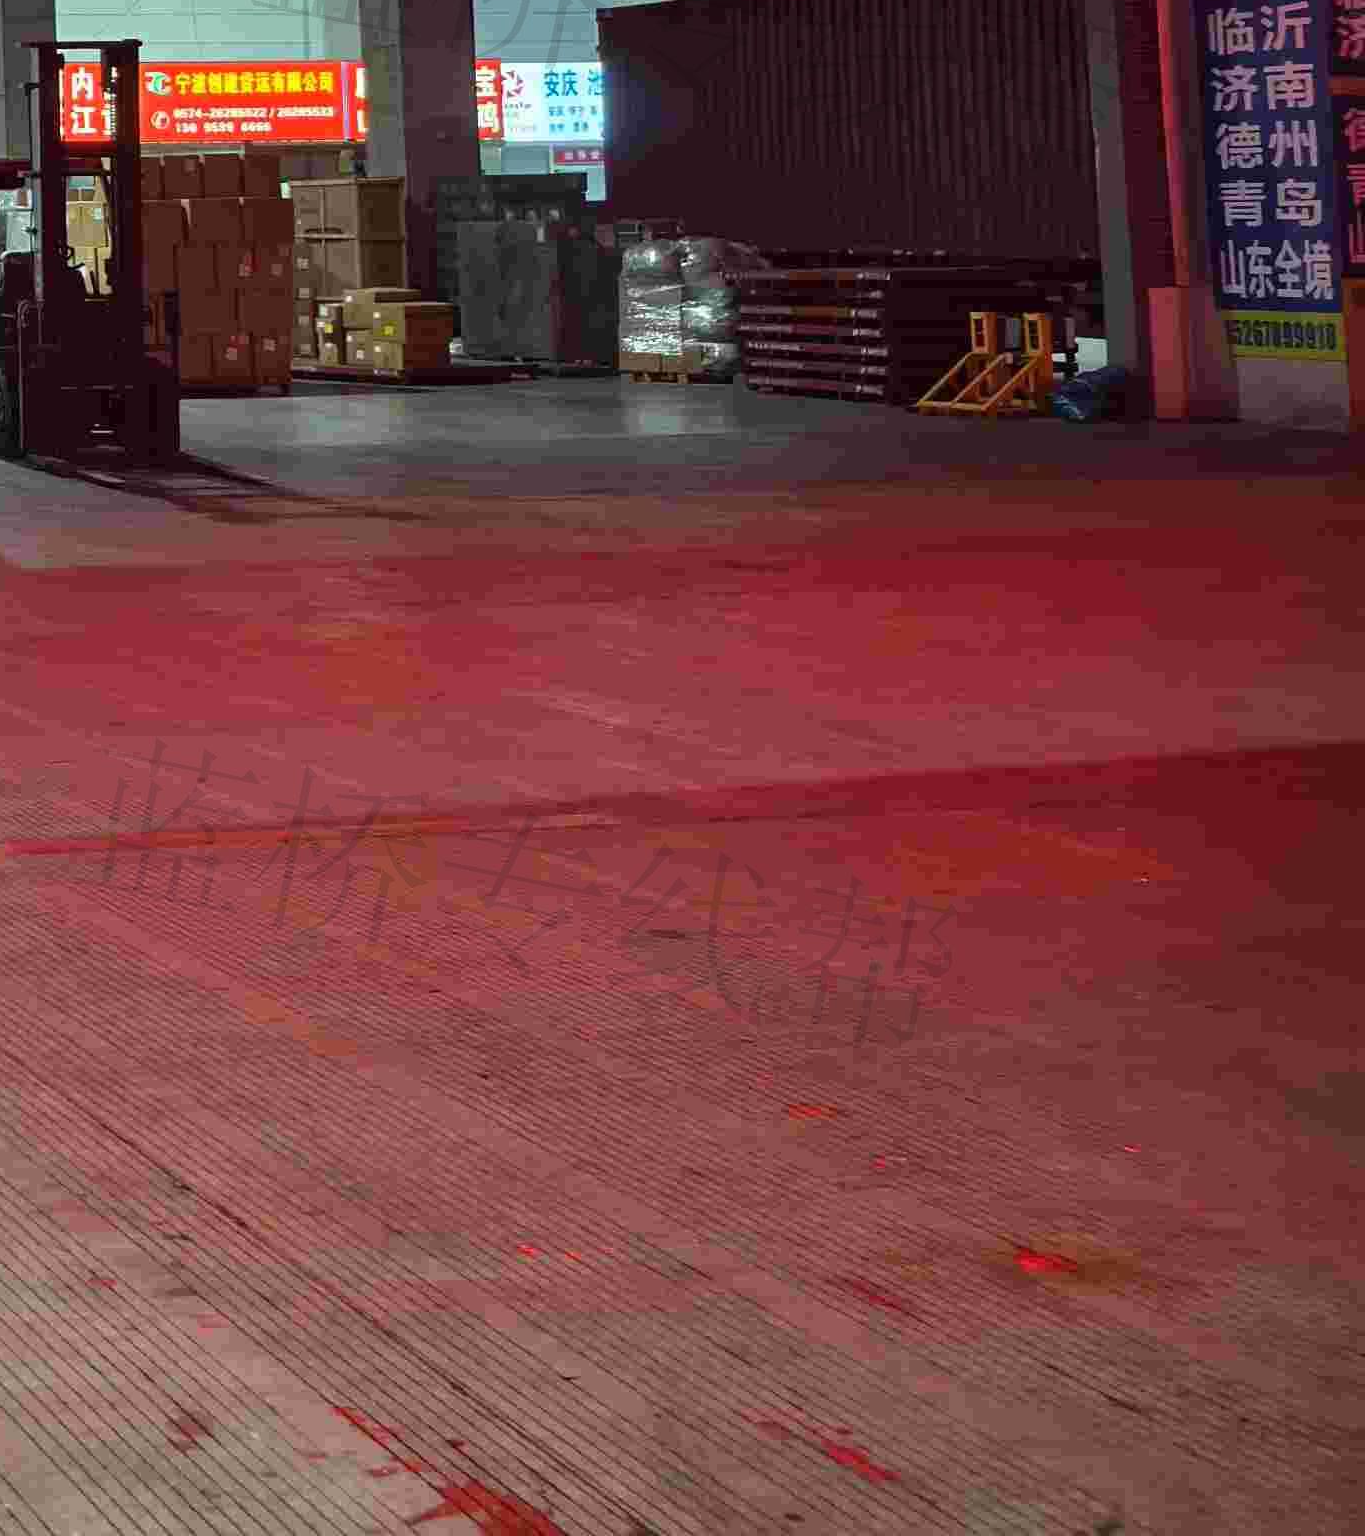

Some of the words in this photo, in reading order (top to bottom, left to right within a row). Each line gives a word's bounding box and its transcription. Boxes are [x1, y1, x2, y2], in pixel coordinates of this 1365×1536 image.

[1207, 0, 1312, 58] 临沂
[544, 69, 579, 97] 安庆
[1212, 62, 1315, 115] 济南
[1215, 118, 1318, 171] 德州
[1219, 177, 1323, 229] 青岛
[1220, 239, 1334, 300] 山东全境
